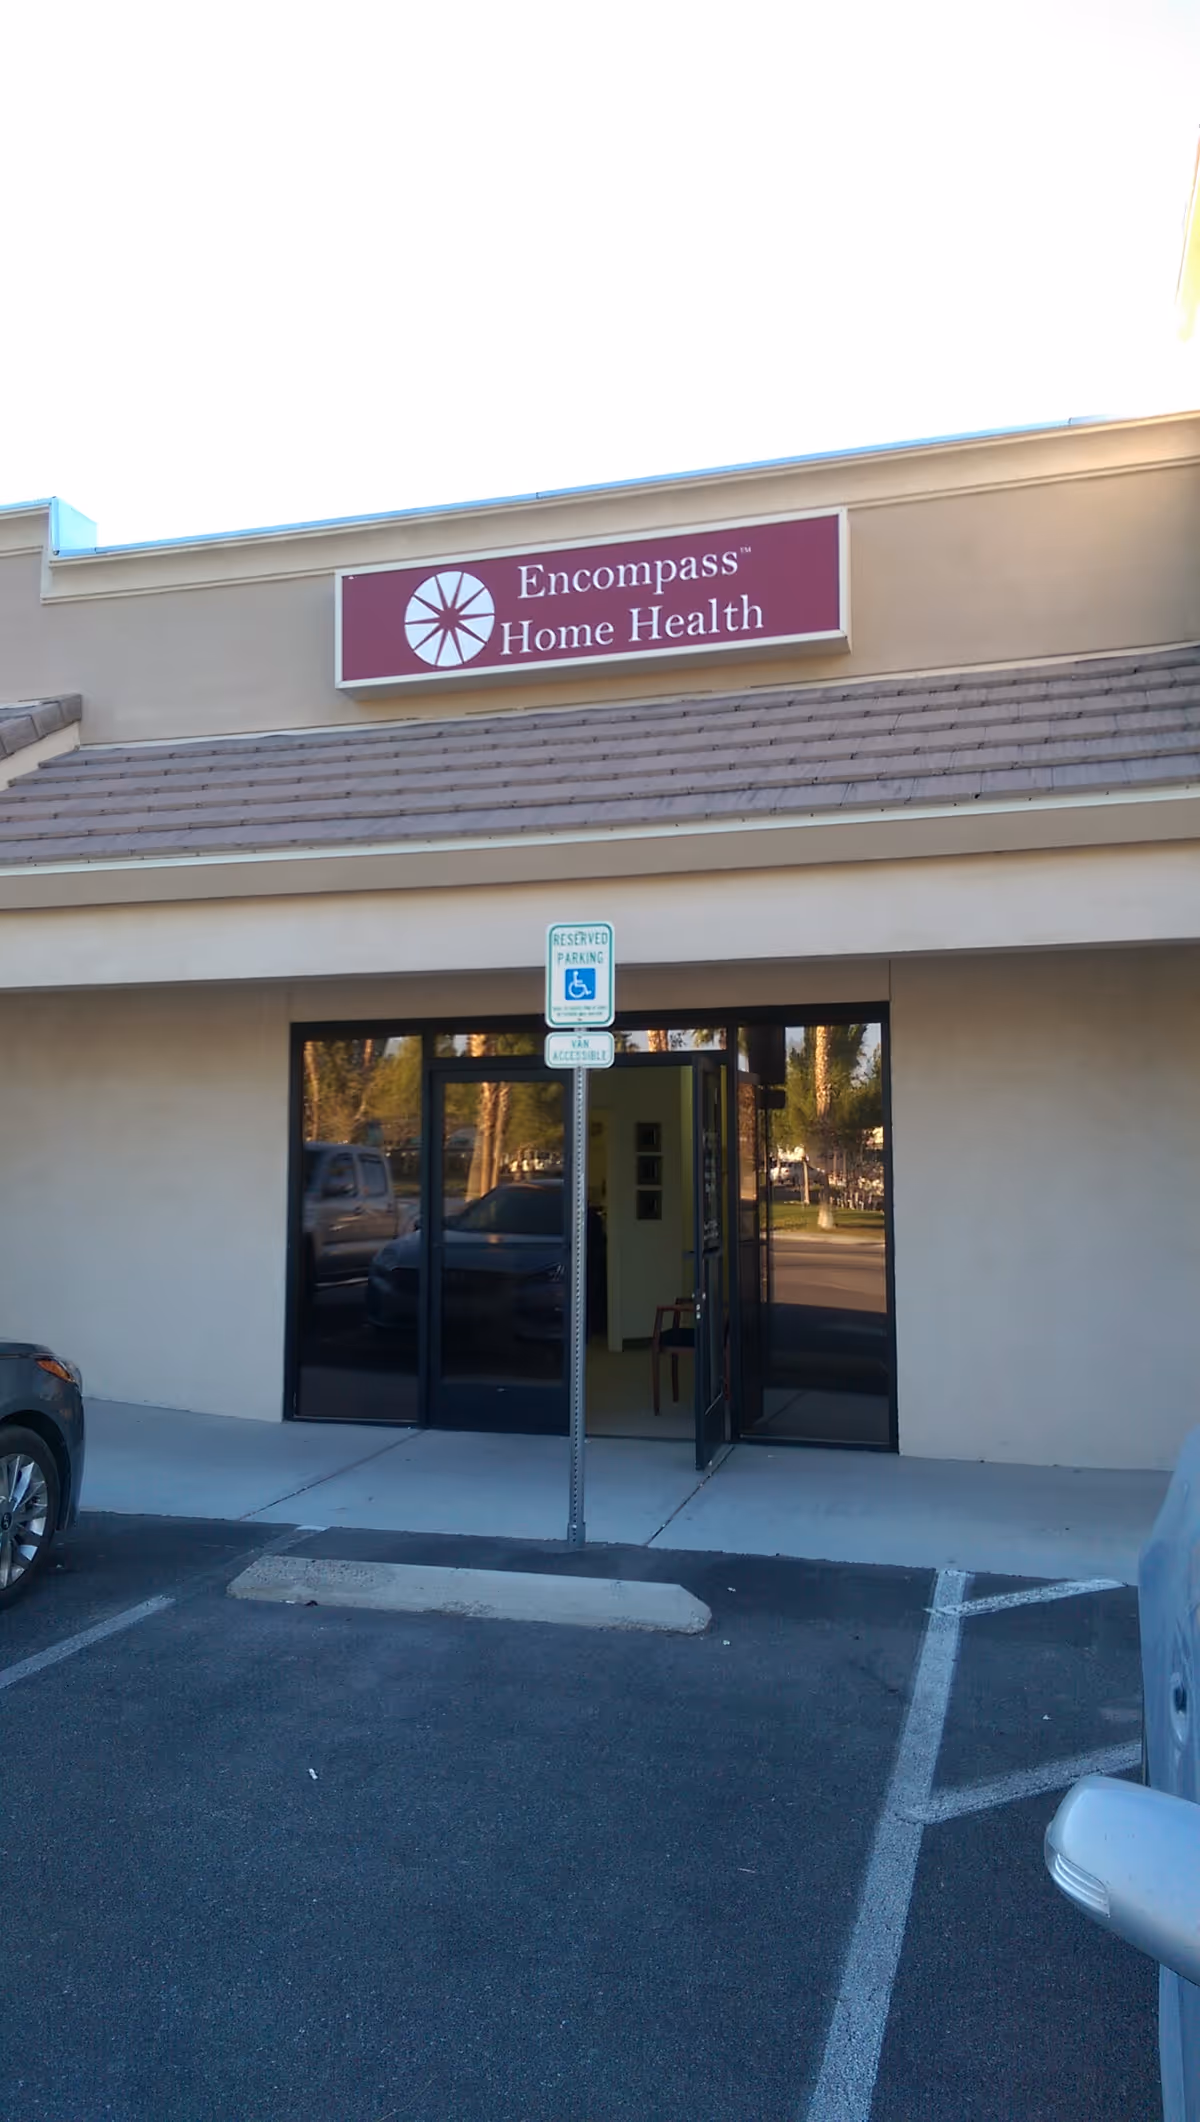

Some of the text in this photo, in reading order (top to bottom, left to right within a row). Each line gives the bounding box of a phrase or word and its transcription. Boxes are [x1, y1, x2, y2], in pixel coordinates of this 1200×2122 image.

[517, 551, 738, 599] Encompass
[500, 594, 764, 655] Home Health
[553, 932, 608, 946] RESERVED
[557, 951, 604, 965] PARKING
[571, 1039, 590, 1049] VAN
[552, 1050, 607, 1061] ACCESSIBLE
